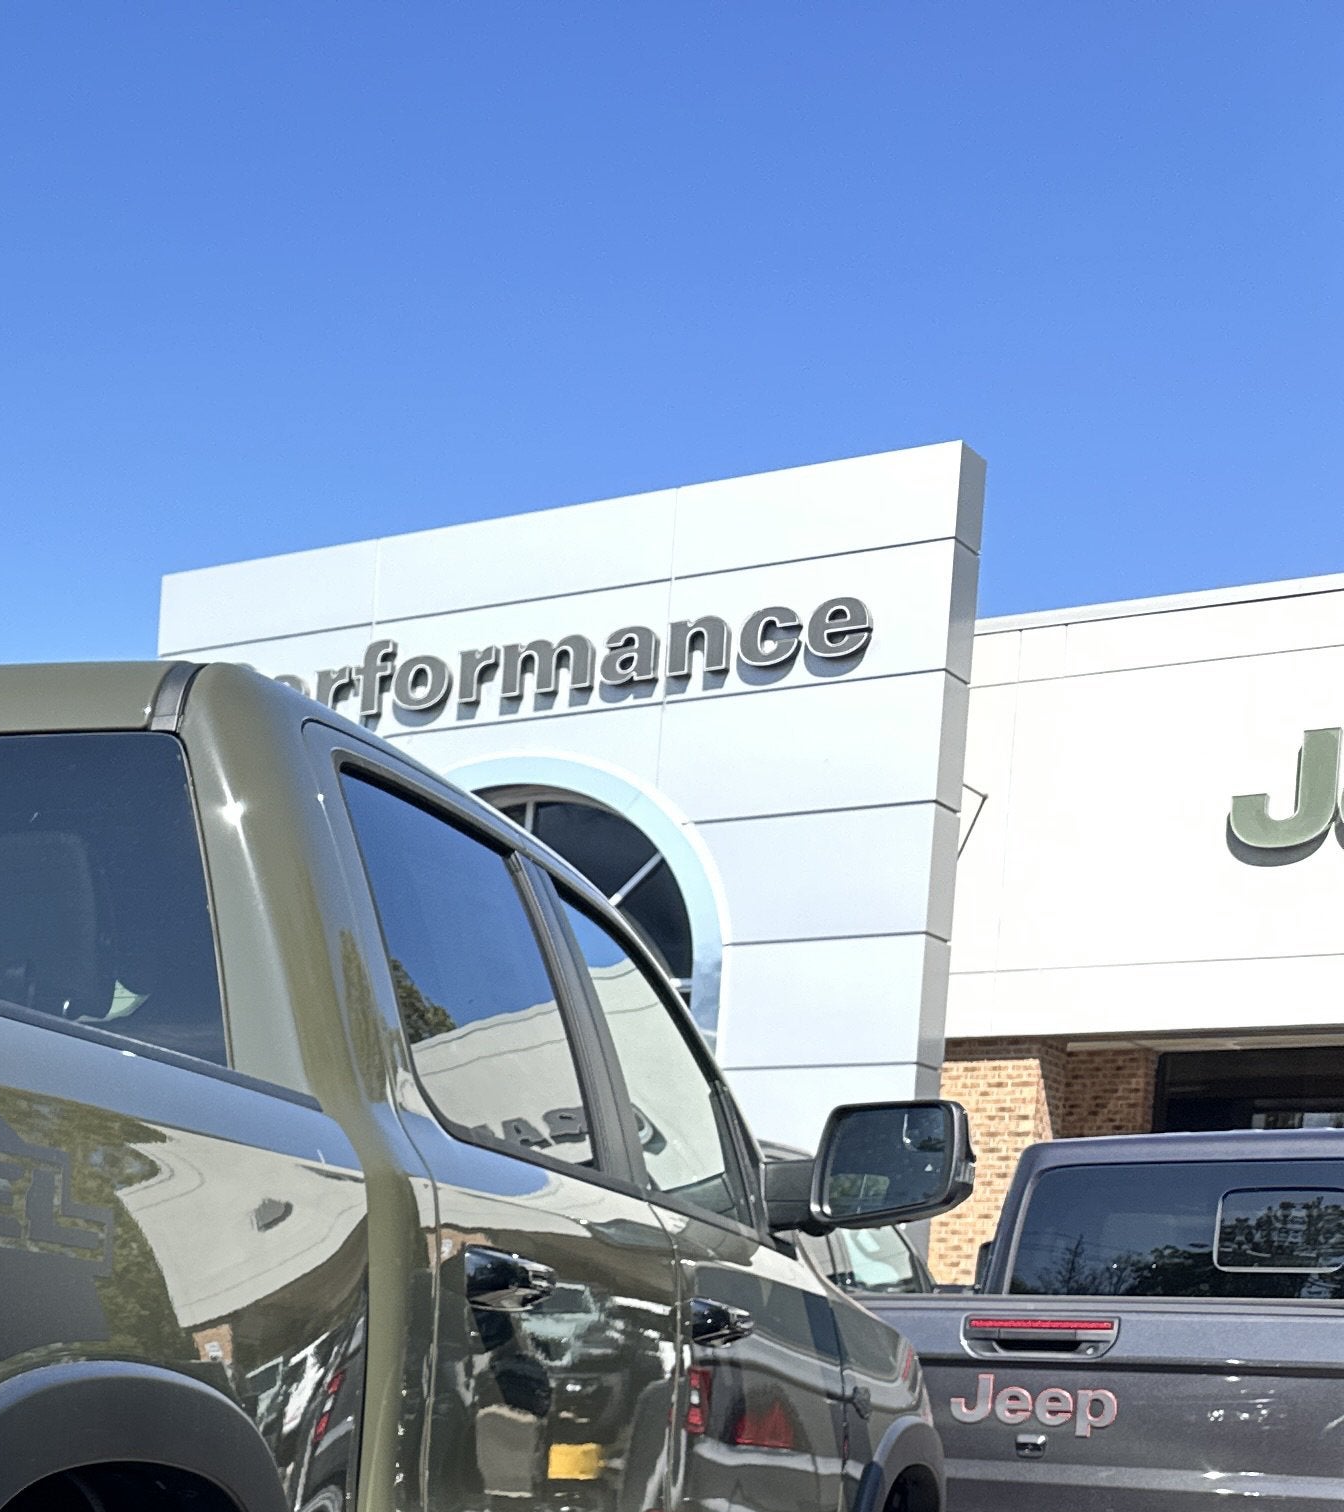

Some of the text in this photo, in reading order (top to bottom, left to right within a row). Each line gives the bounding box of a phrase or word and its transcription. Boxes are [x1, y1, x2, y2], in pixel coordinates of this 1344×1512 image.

[234, 596, 874, 716] rformance
[1231, 727, 1344, 848] J
[950, 1374, 1118, 1438] Jeep
